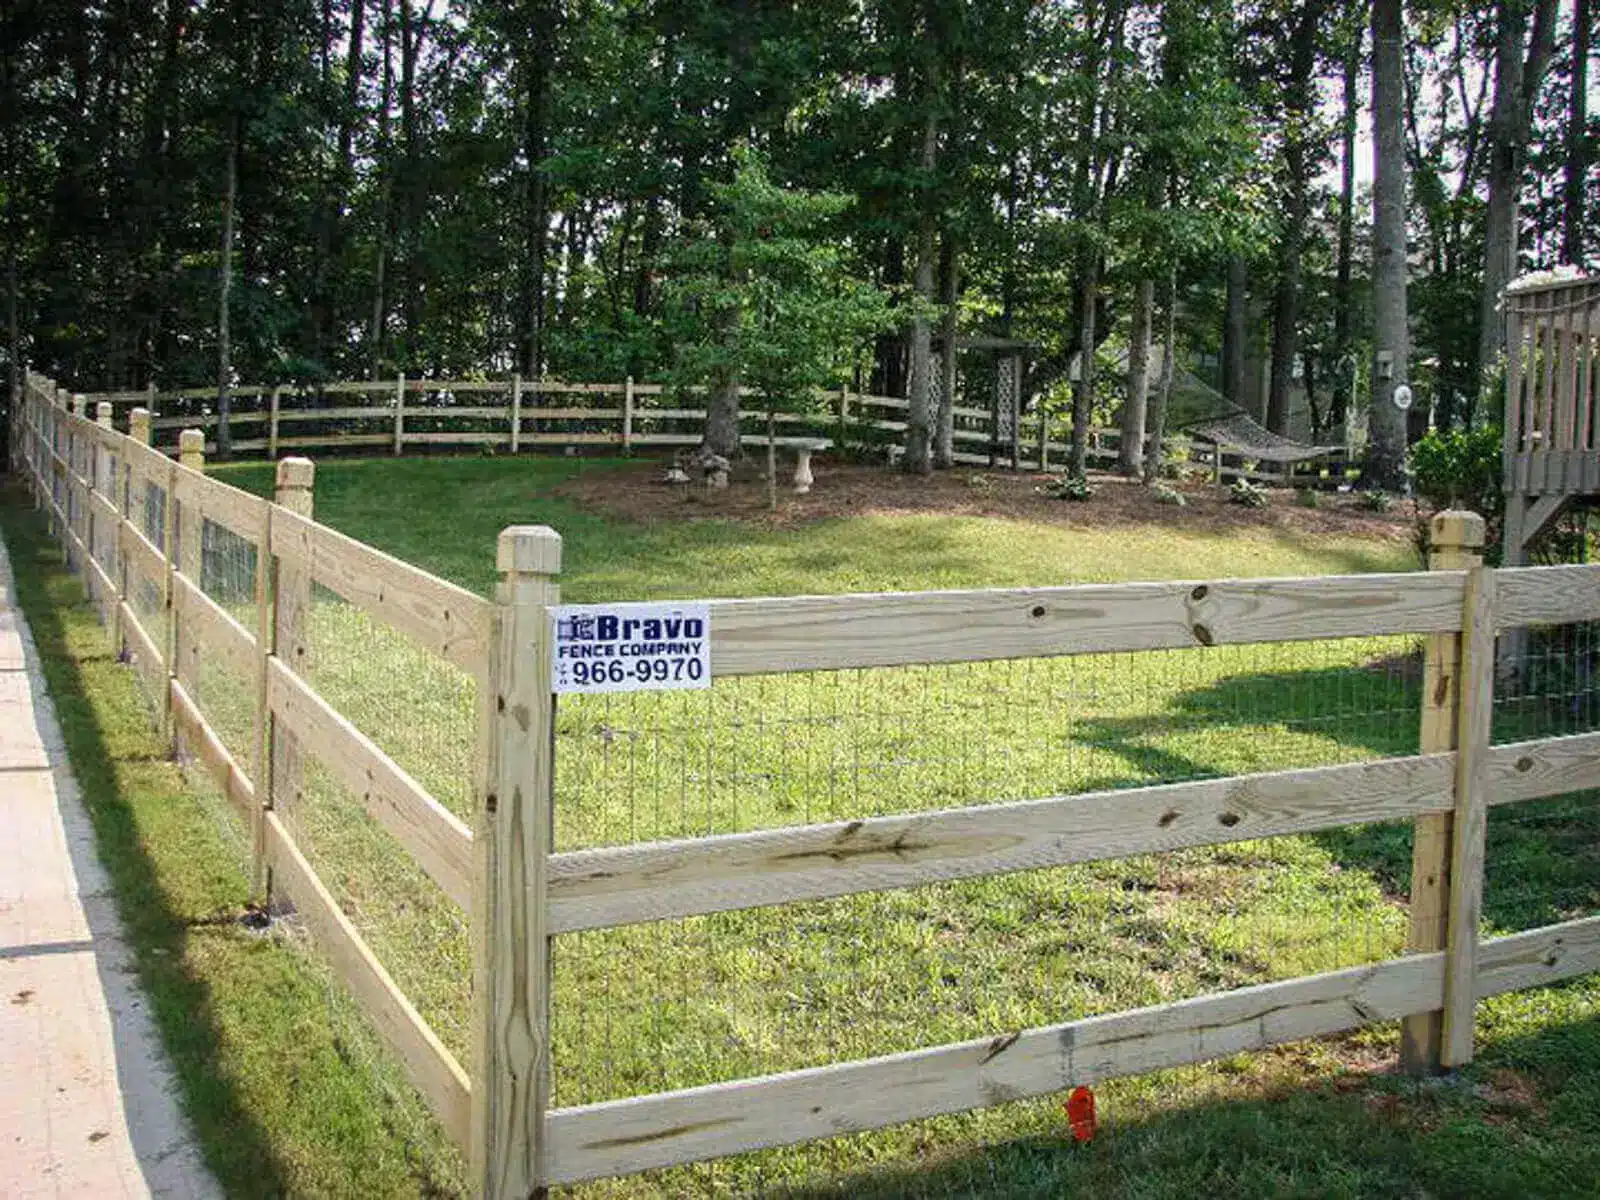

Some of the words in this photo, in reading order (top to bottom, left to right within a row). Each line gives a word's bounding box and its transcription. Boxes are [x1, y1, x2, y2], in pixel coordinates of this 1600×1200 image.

[597, 614, 703, 641] Bravo
[559, 645, 614, 659] FENCE
[619, 643, 702, 657] COMPANY
[573, 657, 702, 685] 966-9970
